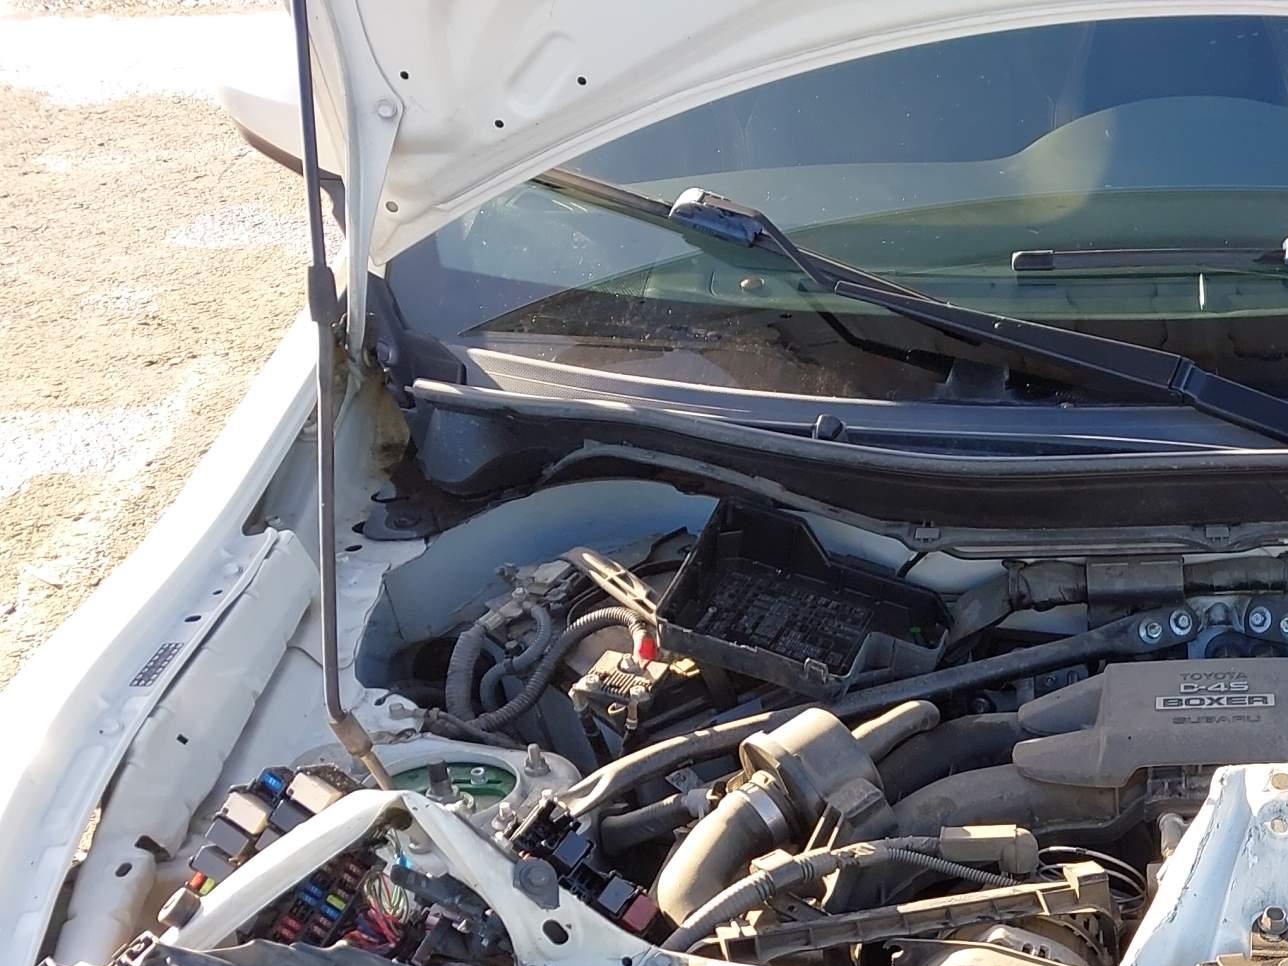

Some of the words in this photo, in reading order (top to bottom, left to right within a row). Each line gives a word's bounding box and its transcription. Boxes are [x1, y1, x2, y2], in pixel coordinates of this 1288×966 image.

[1180, 672, 1248, 681] TOYOTA
[1180, 681, 1249, 693] D-4S
[1162, 696, 1269, 708] BOXER
[1172, 715, 1261, 725] SUBARU
